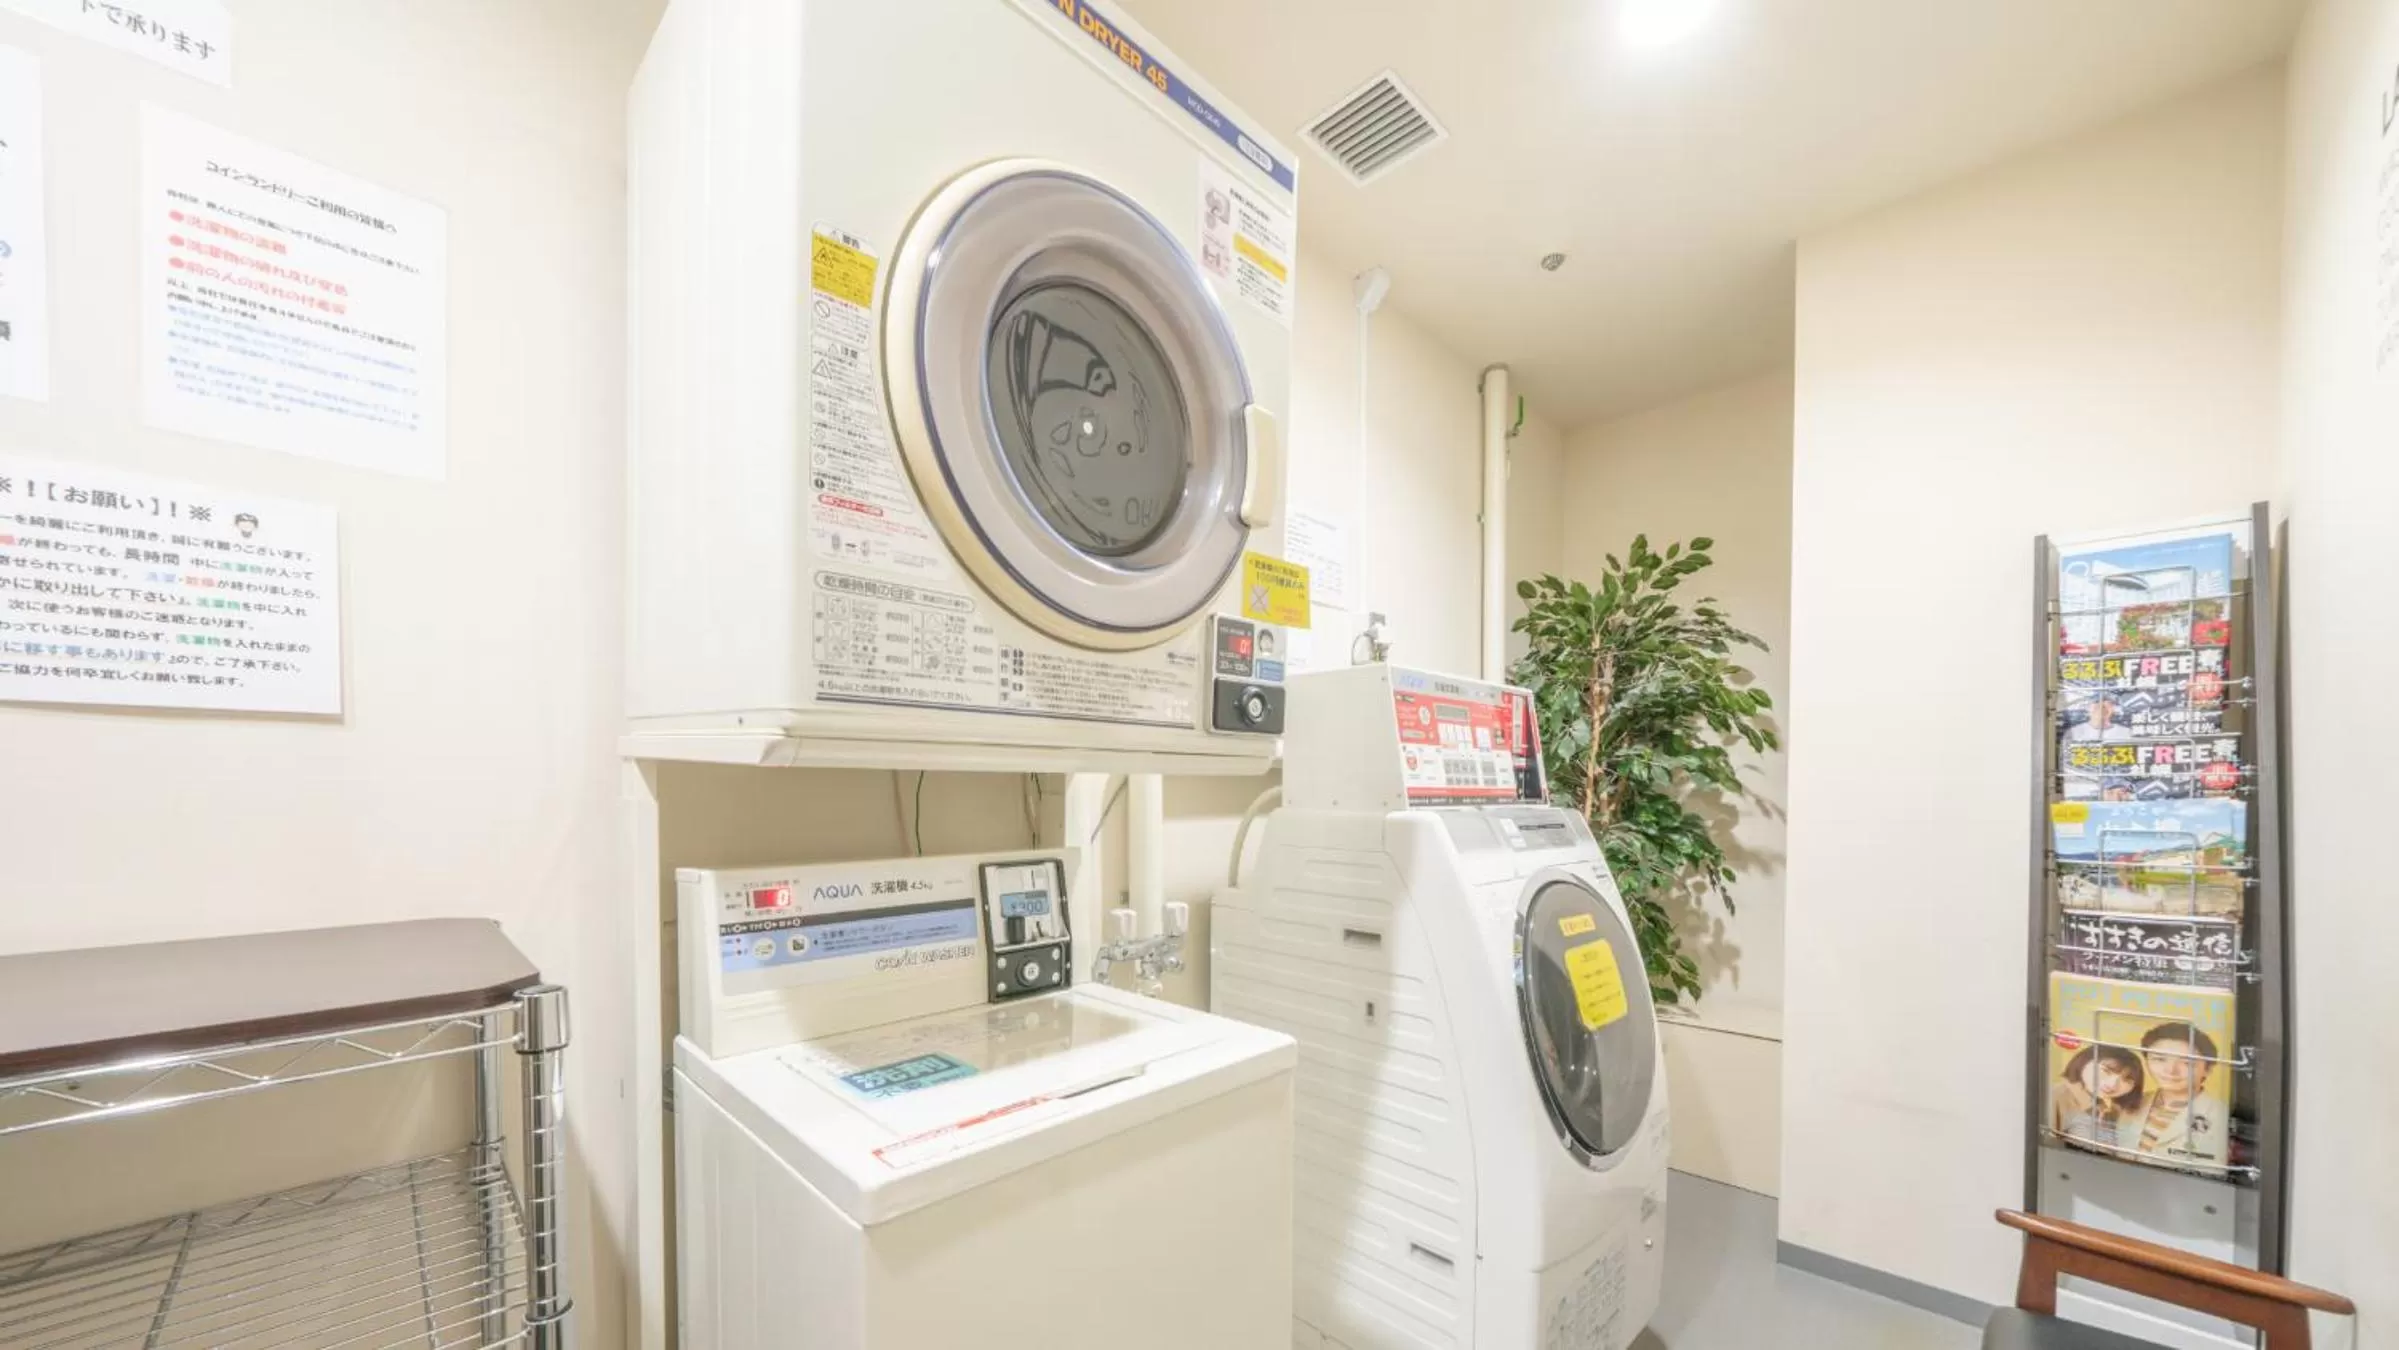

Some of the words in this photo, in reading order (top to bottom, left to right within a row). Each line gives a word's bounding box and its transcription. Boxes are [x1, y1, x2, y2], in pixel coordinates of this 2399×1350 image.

[1079, 6, 1143, 73] DRYER
[1146, 64, 1168, 94] 45
[2124, 654, 2193, 677] FREE
[2137, 744, 2212, 764] FREE
[813, 884, 864, 902] AQUA
[871, 880, 908, 895] 洗濯機
